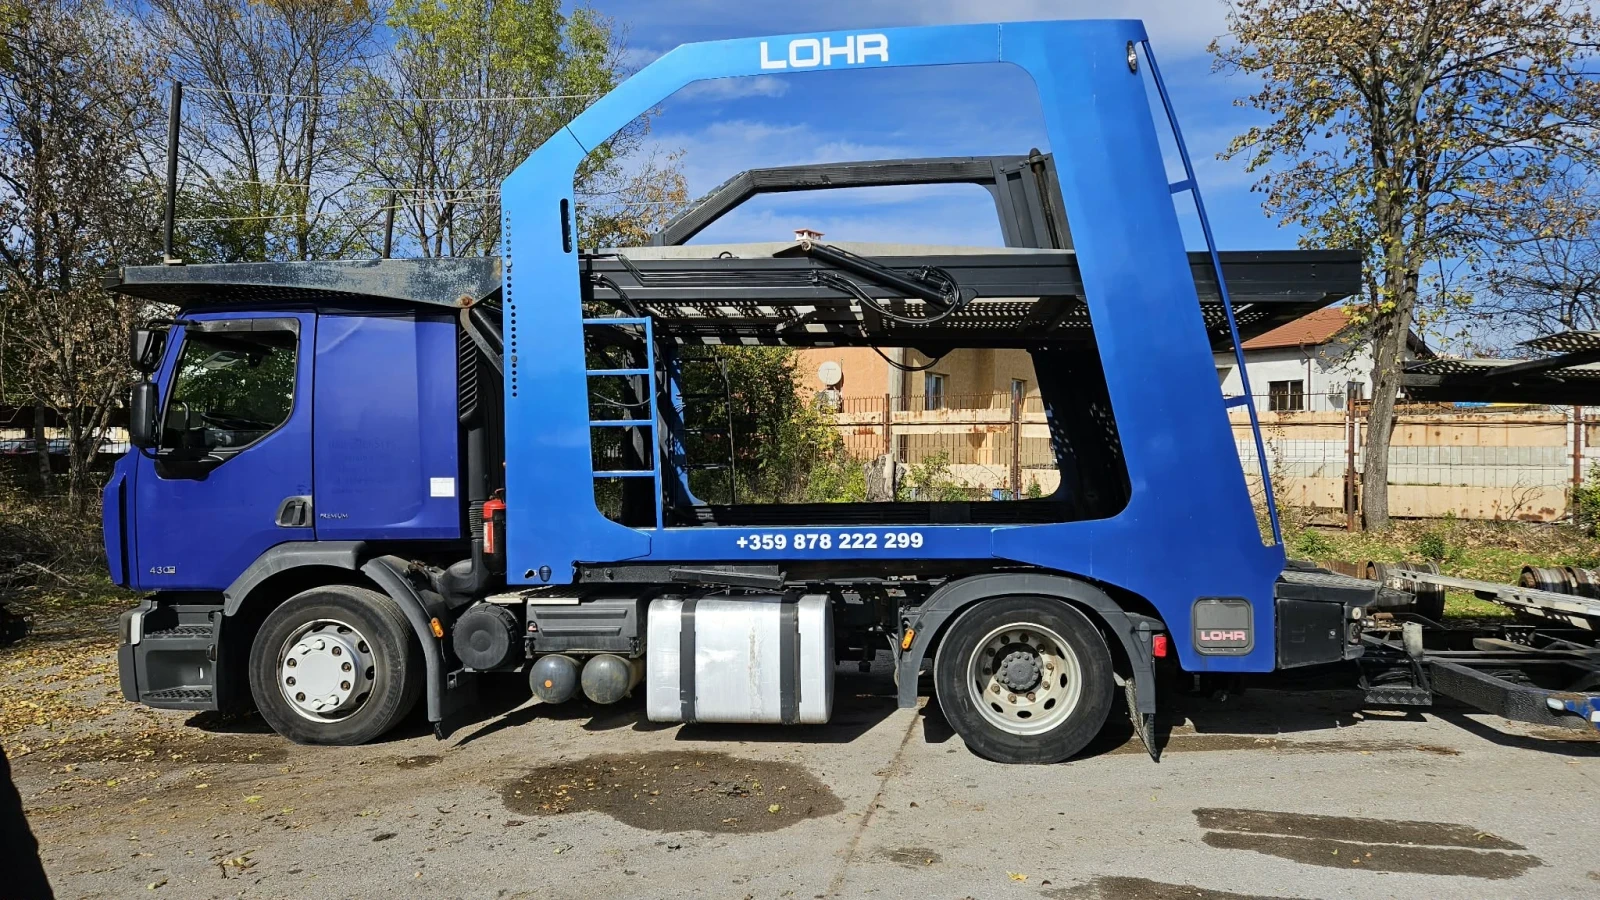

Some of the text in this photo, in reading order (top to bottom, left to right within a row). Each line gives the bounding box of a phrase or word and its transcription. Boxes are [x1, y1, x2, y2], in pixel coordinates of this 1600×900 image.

[760, 33, 889, 69] LOHR
[736, 532, 924, 550] +359 878 222 299
[1200, 630, 1246, 641] LOHR
